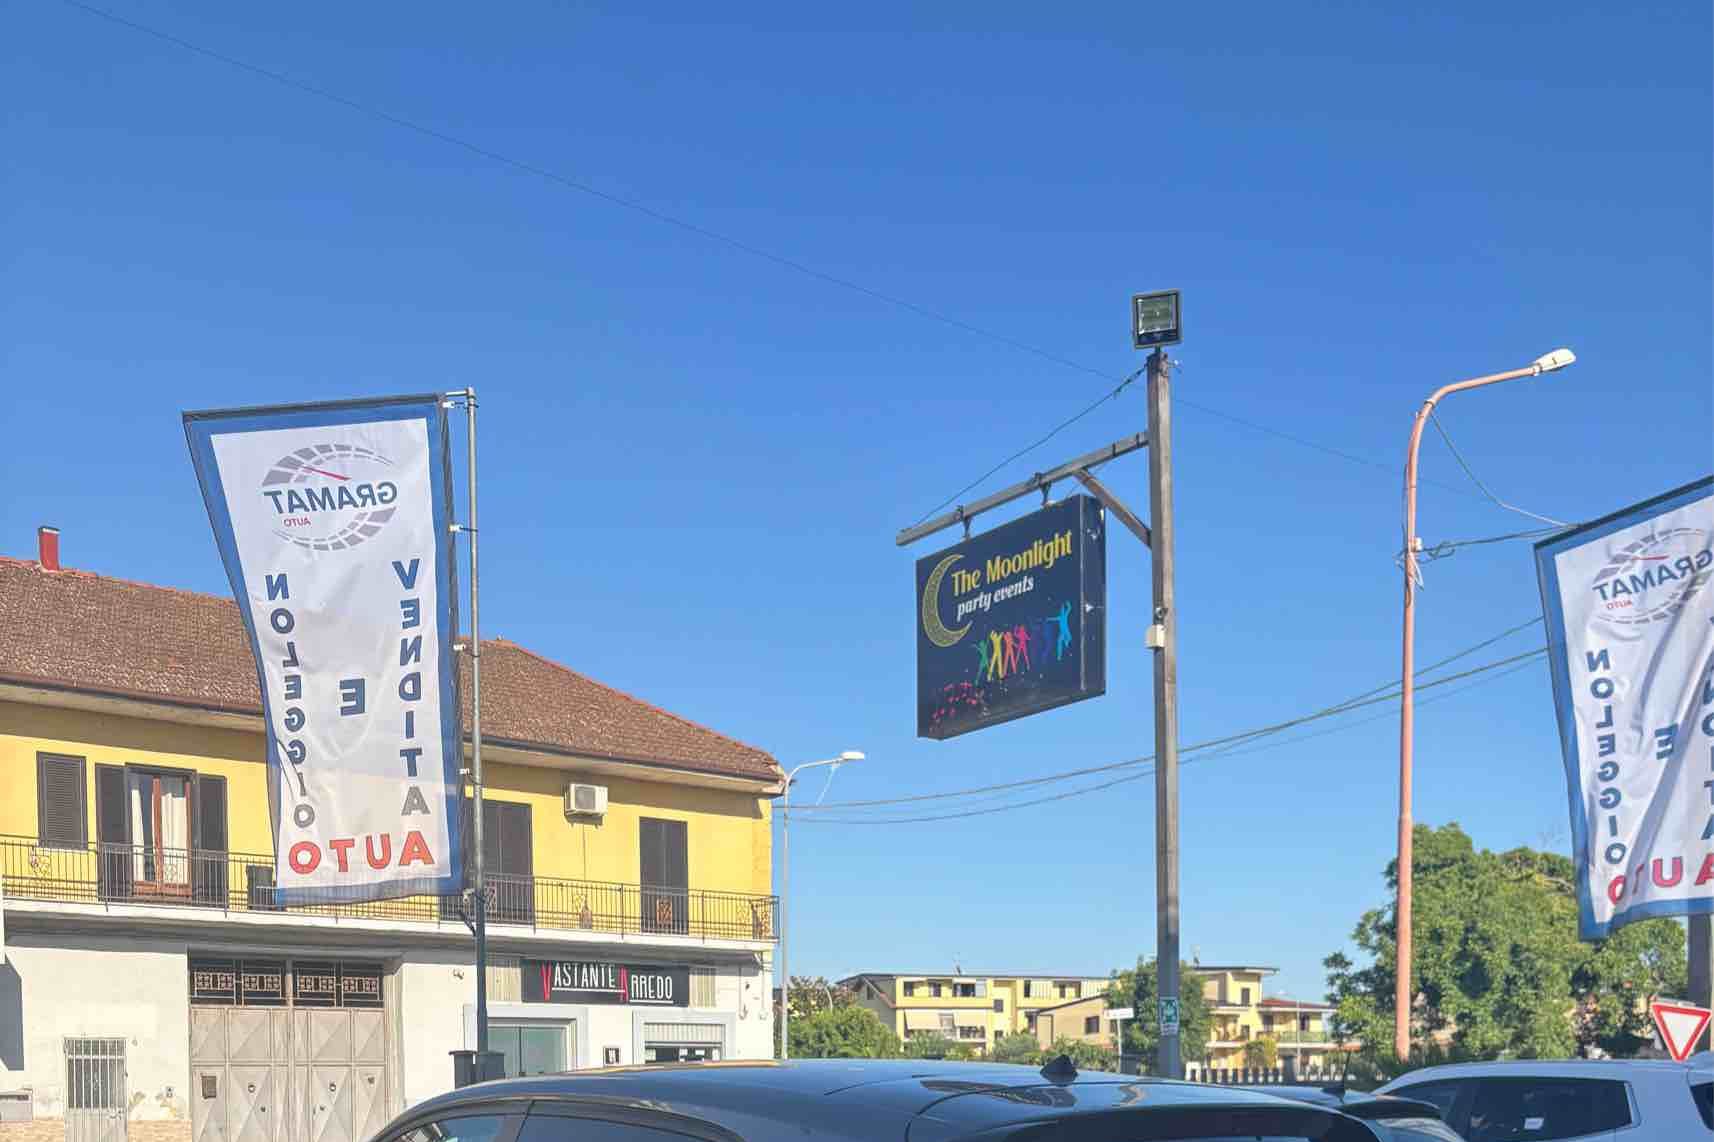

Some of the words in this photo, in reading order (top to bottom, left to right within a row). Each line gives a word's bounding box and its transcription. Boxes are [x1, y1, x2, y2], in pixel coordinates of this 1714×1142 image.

[951, 569, 981, 597] The
[986, 529, 1073, 585] Moonlight
[957, 588, 991, 622] party
[993, 574, 1035, 603] events
[540, 960, 617, 1002] VASTANTE
[618, 966, 673, 1004] ARREDO
